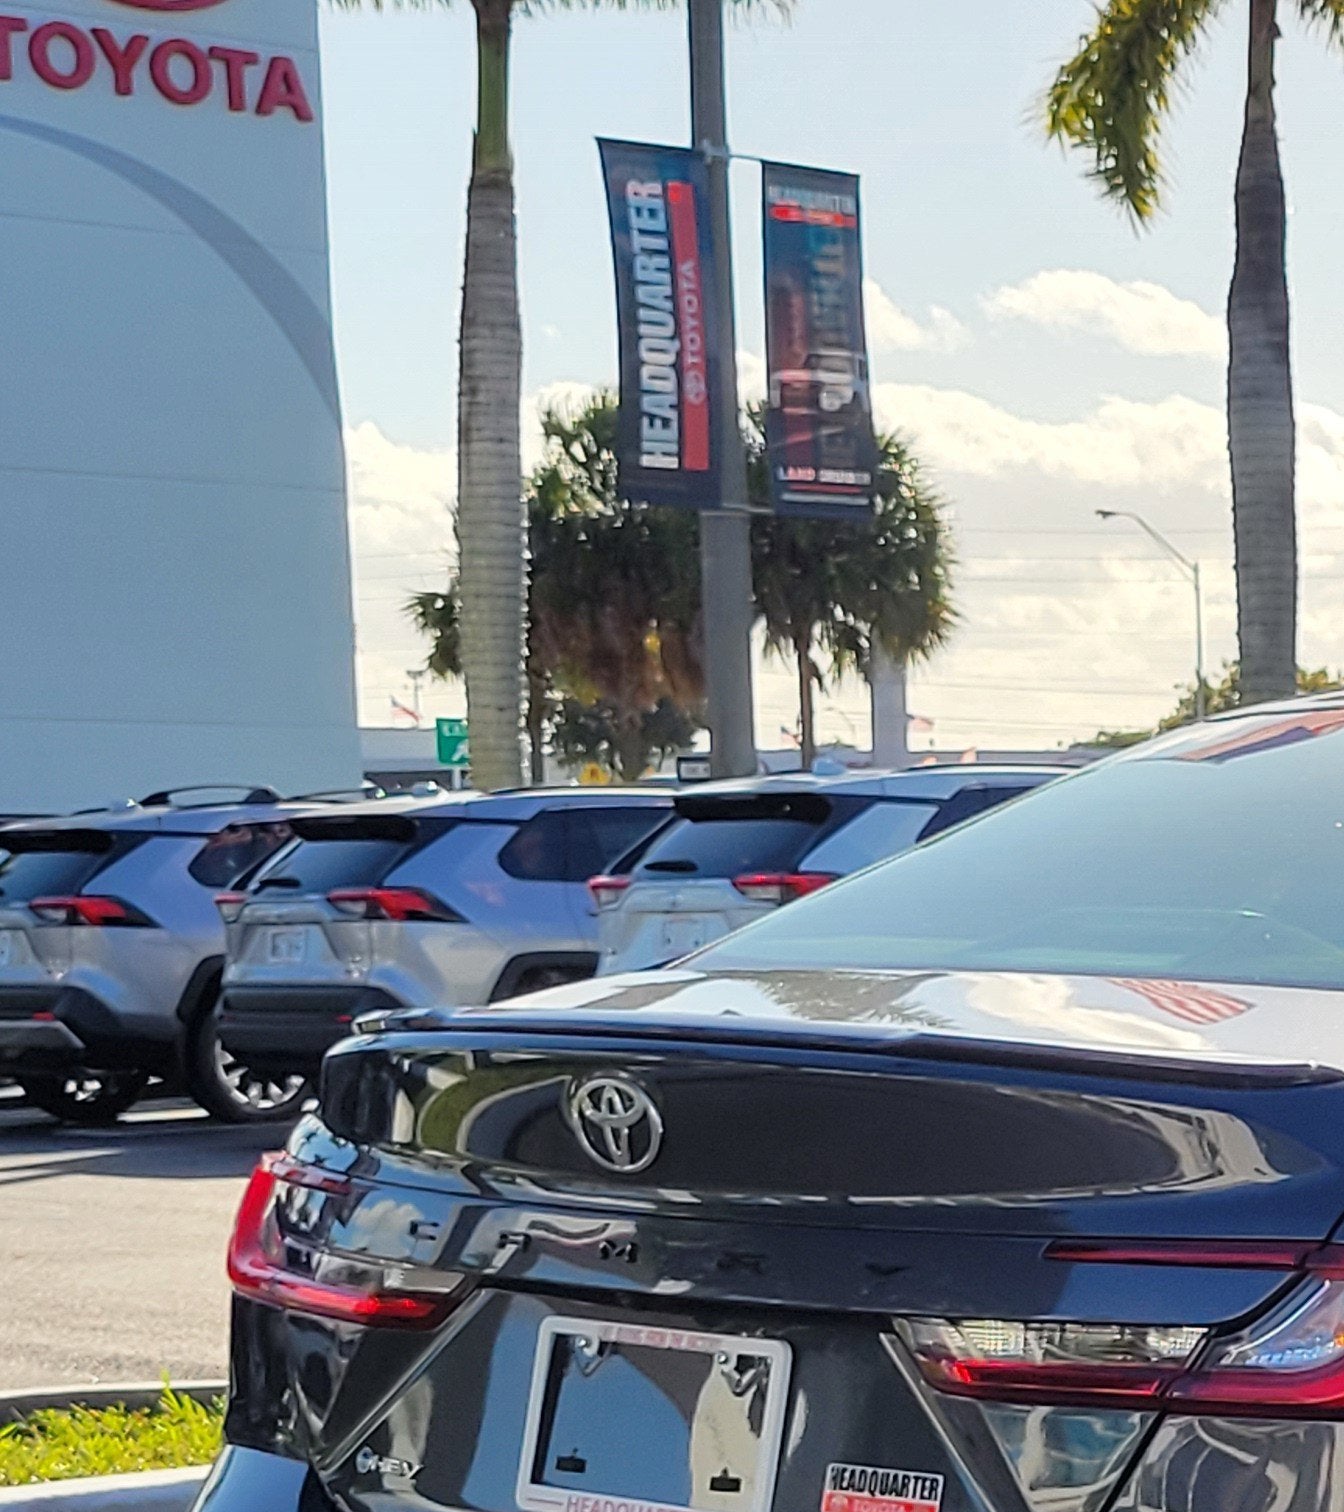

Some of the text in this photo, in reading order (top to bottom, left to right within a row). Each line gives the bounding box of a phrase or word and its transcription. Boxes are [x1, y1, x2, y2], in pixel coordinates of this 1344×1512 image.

[626, 179, 681, 469] HEADQUARTER
[677, 260, 702, 366] TOYOTA
[830, 1466, 940, 1501] HEADQUARTER
